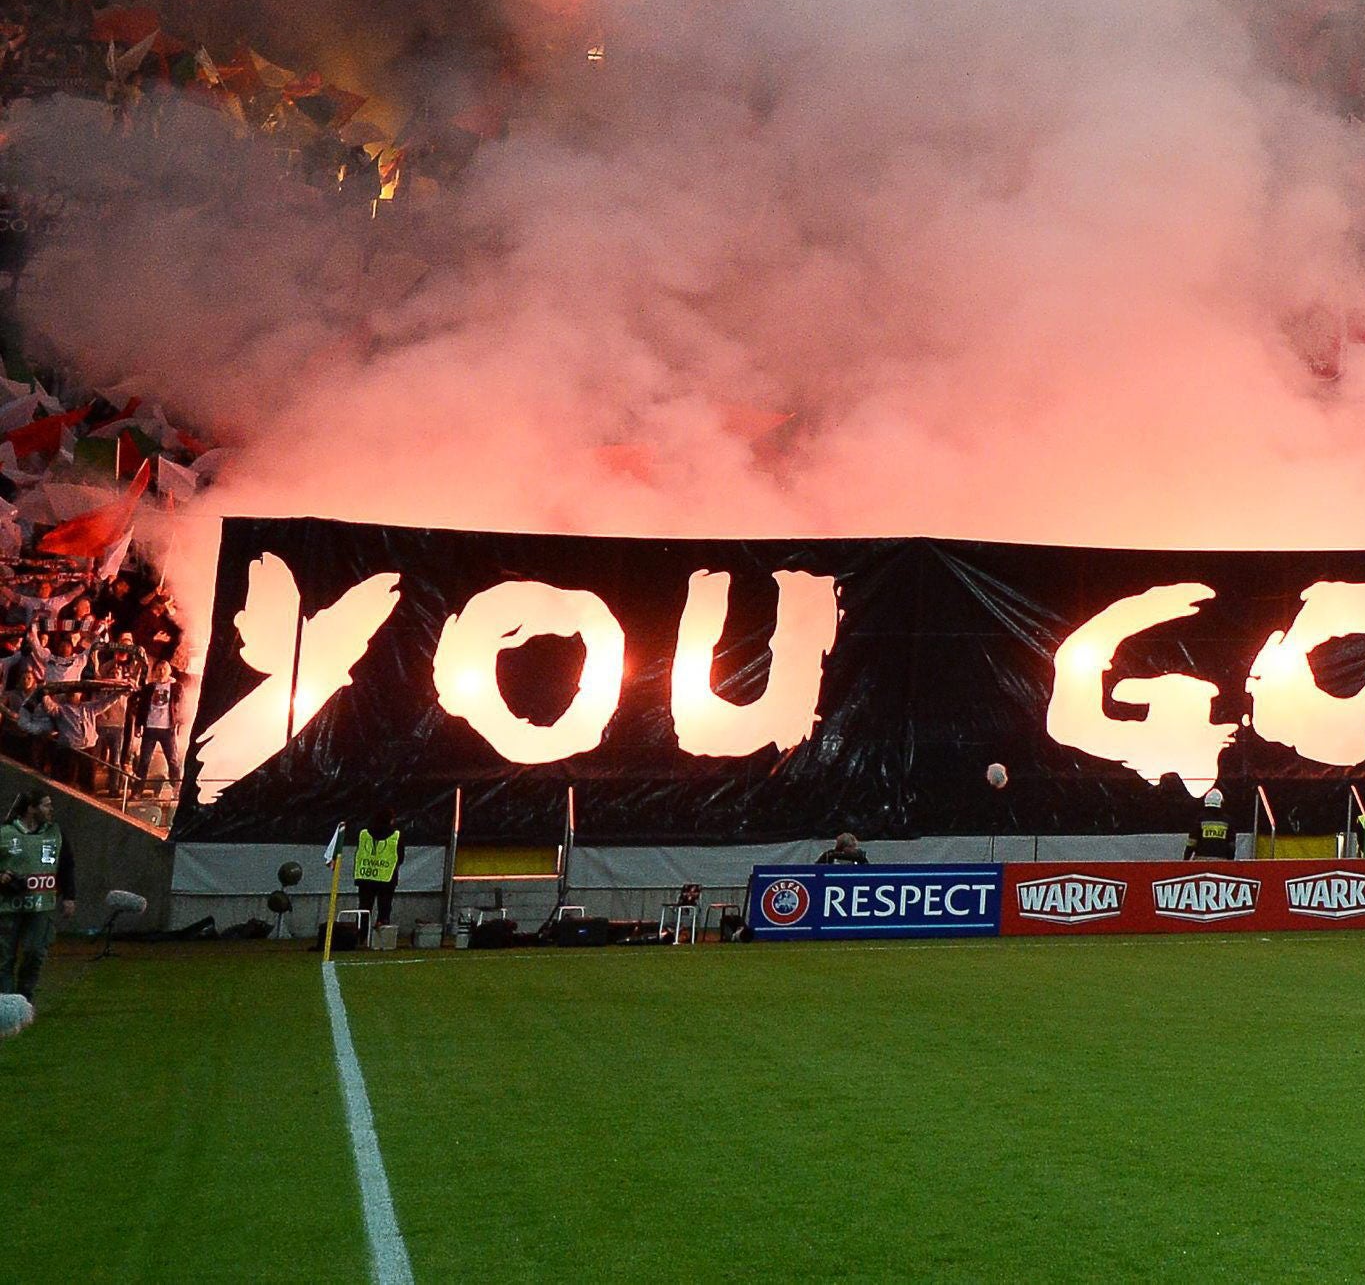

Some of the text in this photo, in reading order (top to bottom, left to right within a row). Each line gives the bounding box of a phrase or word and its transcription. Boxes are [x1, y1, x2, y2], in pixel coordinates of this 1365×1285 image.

[197, 552, 845, 805] YOU
[27, 876, 56, 889] OTO
[771, 881, 800, 894] UEFA
[1020, 882, 1119, 913] WARKA
[1154, 881, 1253, 912] WARKA
[822, 884, 996, 918] RESPECT
